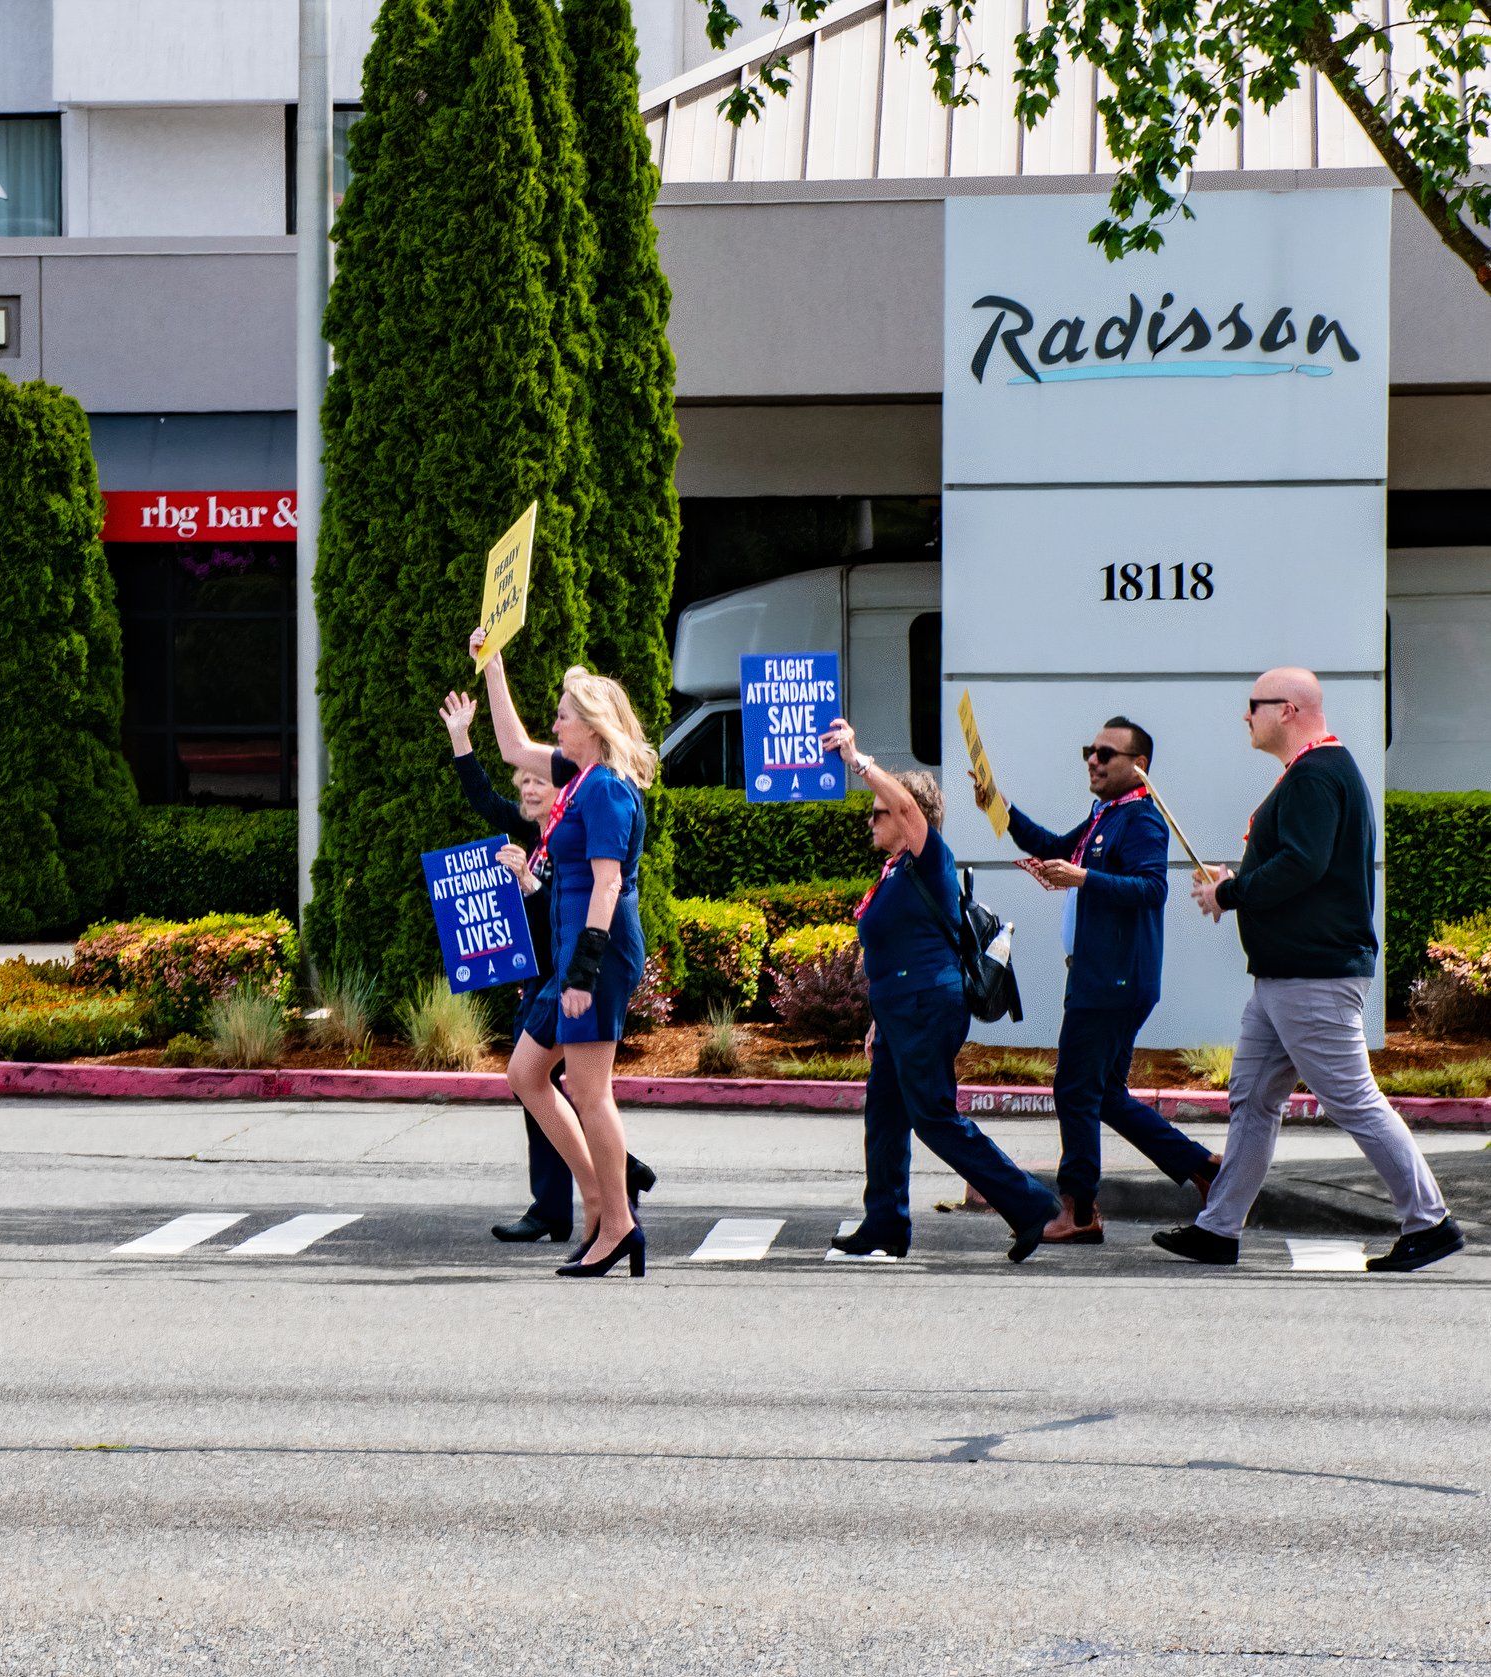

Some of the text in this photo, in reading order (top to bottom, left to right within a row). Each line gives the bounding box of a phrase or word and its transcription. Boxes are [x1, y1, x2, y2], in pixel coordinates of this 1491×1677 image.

[970, 292, 1361, 384] Radisson
[140, 496, 199, 539] rbg
[206, 496, 268, 528] bar
[494, 542, 521, 582] READY
[498, 568, 514, 597] FOR
[1099, 562, 1214, 601] 18118
[765, 659, 814, 681] FLIGHT
[746, 681, 836, 704] ATTENDANTS
[767, 705, 817, 735] SAVE
[763, 735, 825, 765] LIVES!
[444, 846, 489, 875] FLIGHT
[433, 865, 513, 901] ATTENDANTS
[455, 890, 502, 926] SAVE
[456, 918, 514, 956] LIVES!
[971, 1093, 995, 1112] NO
